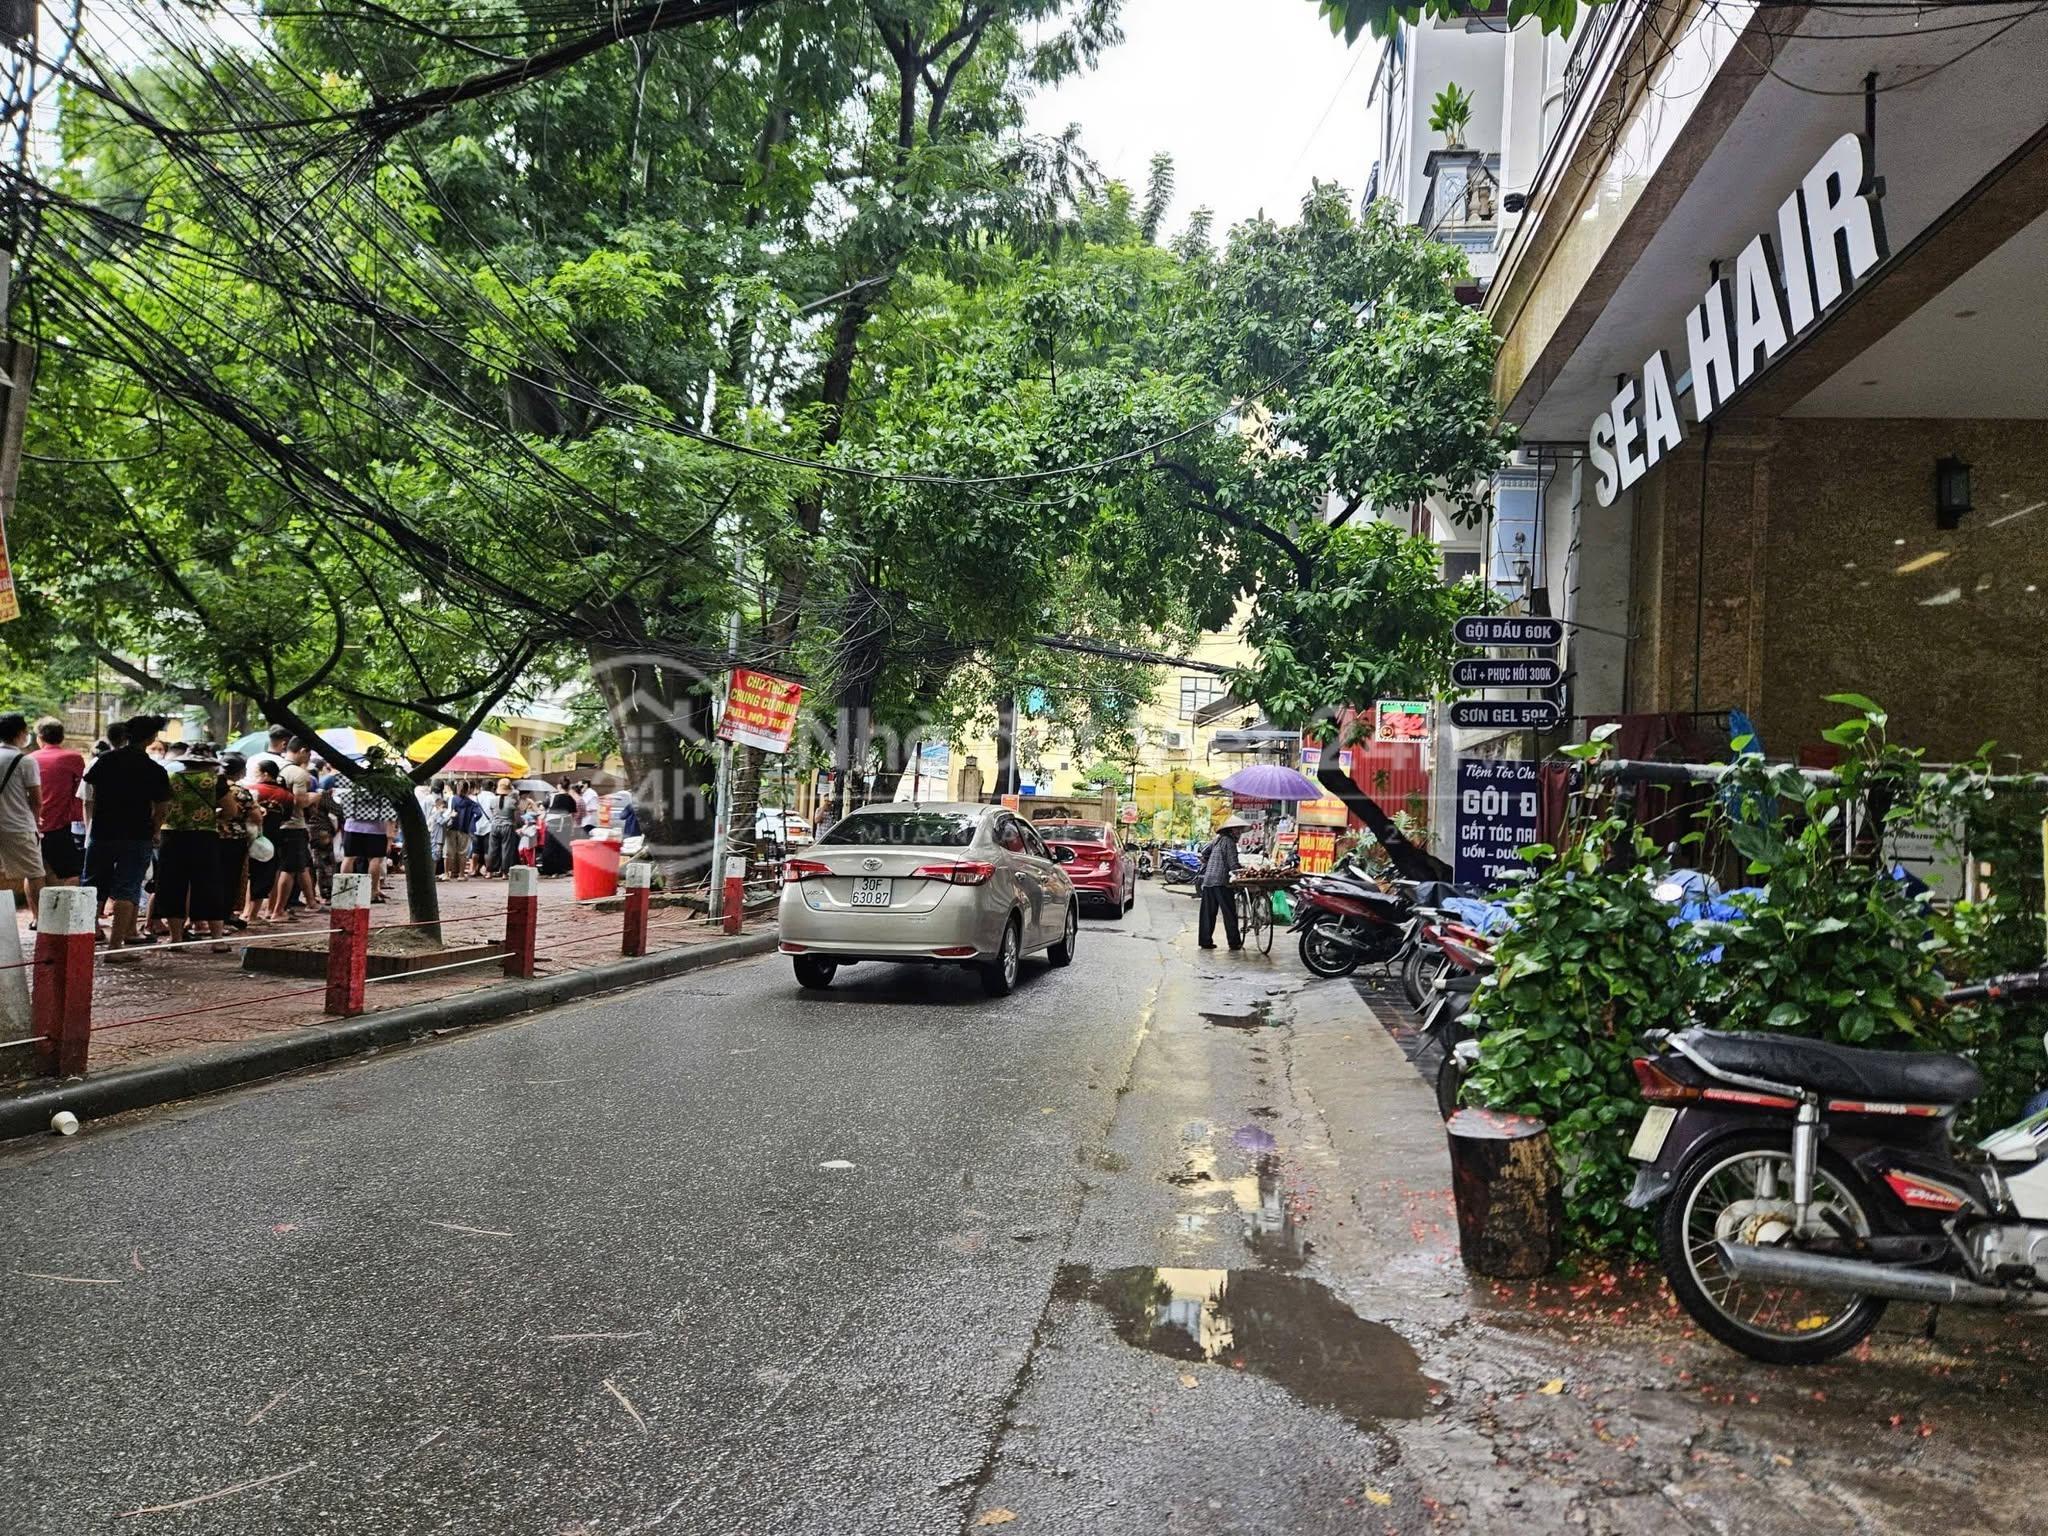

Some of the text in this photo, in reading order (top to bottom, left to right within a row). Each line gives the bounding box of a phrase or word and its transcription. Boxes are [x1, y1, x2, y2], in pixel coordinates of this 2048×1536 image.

[1589, 132, 1880, 507] SEA HAIR
[1465, 621, 1489, 641] GỘI
[1525, 625, 1552, 639] 60K
[746, 675, 766, 691] CHO
[1487, 667, 1511, 684] PHỤC
[1530, 667, 1551, 681] 300K
[730, 688, 760, 706] CHUNG
[727, 706, 747, 720] FULL
[1460, 707, 1488, 722] SƠN
[1493, 709, 1517, 722] GEL
[1466, 764, 1492, 779] Tiệm
[1495, 766, 1515, 779] Tóc
[1463, 784, 1509, 821] GỘI
[1462, 820, 1485, 840] CẮT
[1489, 824, 1512, 842] TÓC
[1462, 843, 1485, 858] UỐN
[862, 879, 882, 891] 30F
[852, 892, 889, 904] 630.87
[1864, 1103, 1907, 1115] HONDA
